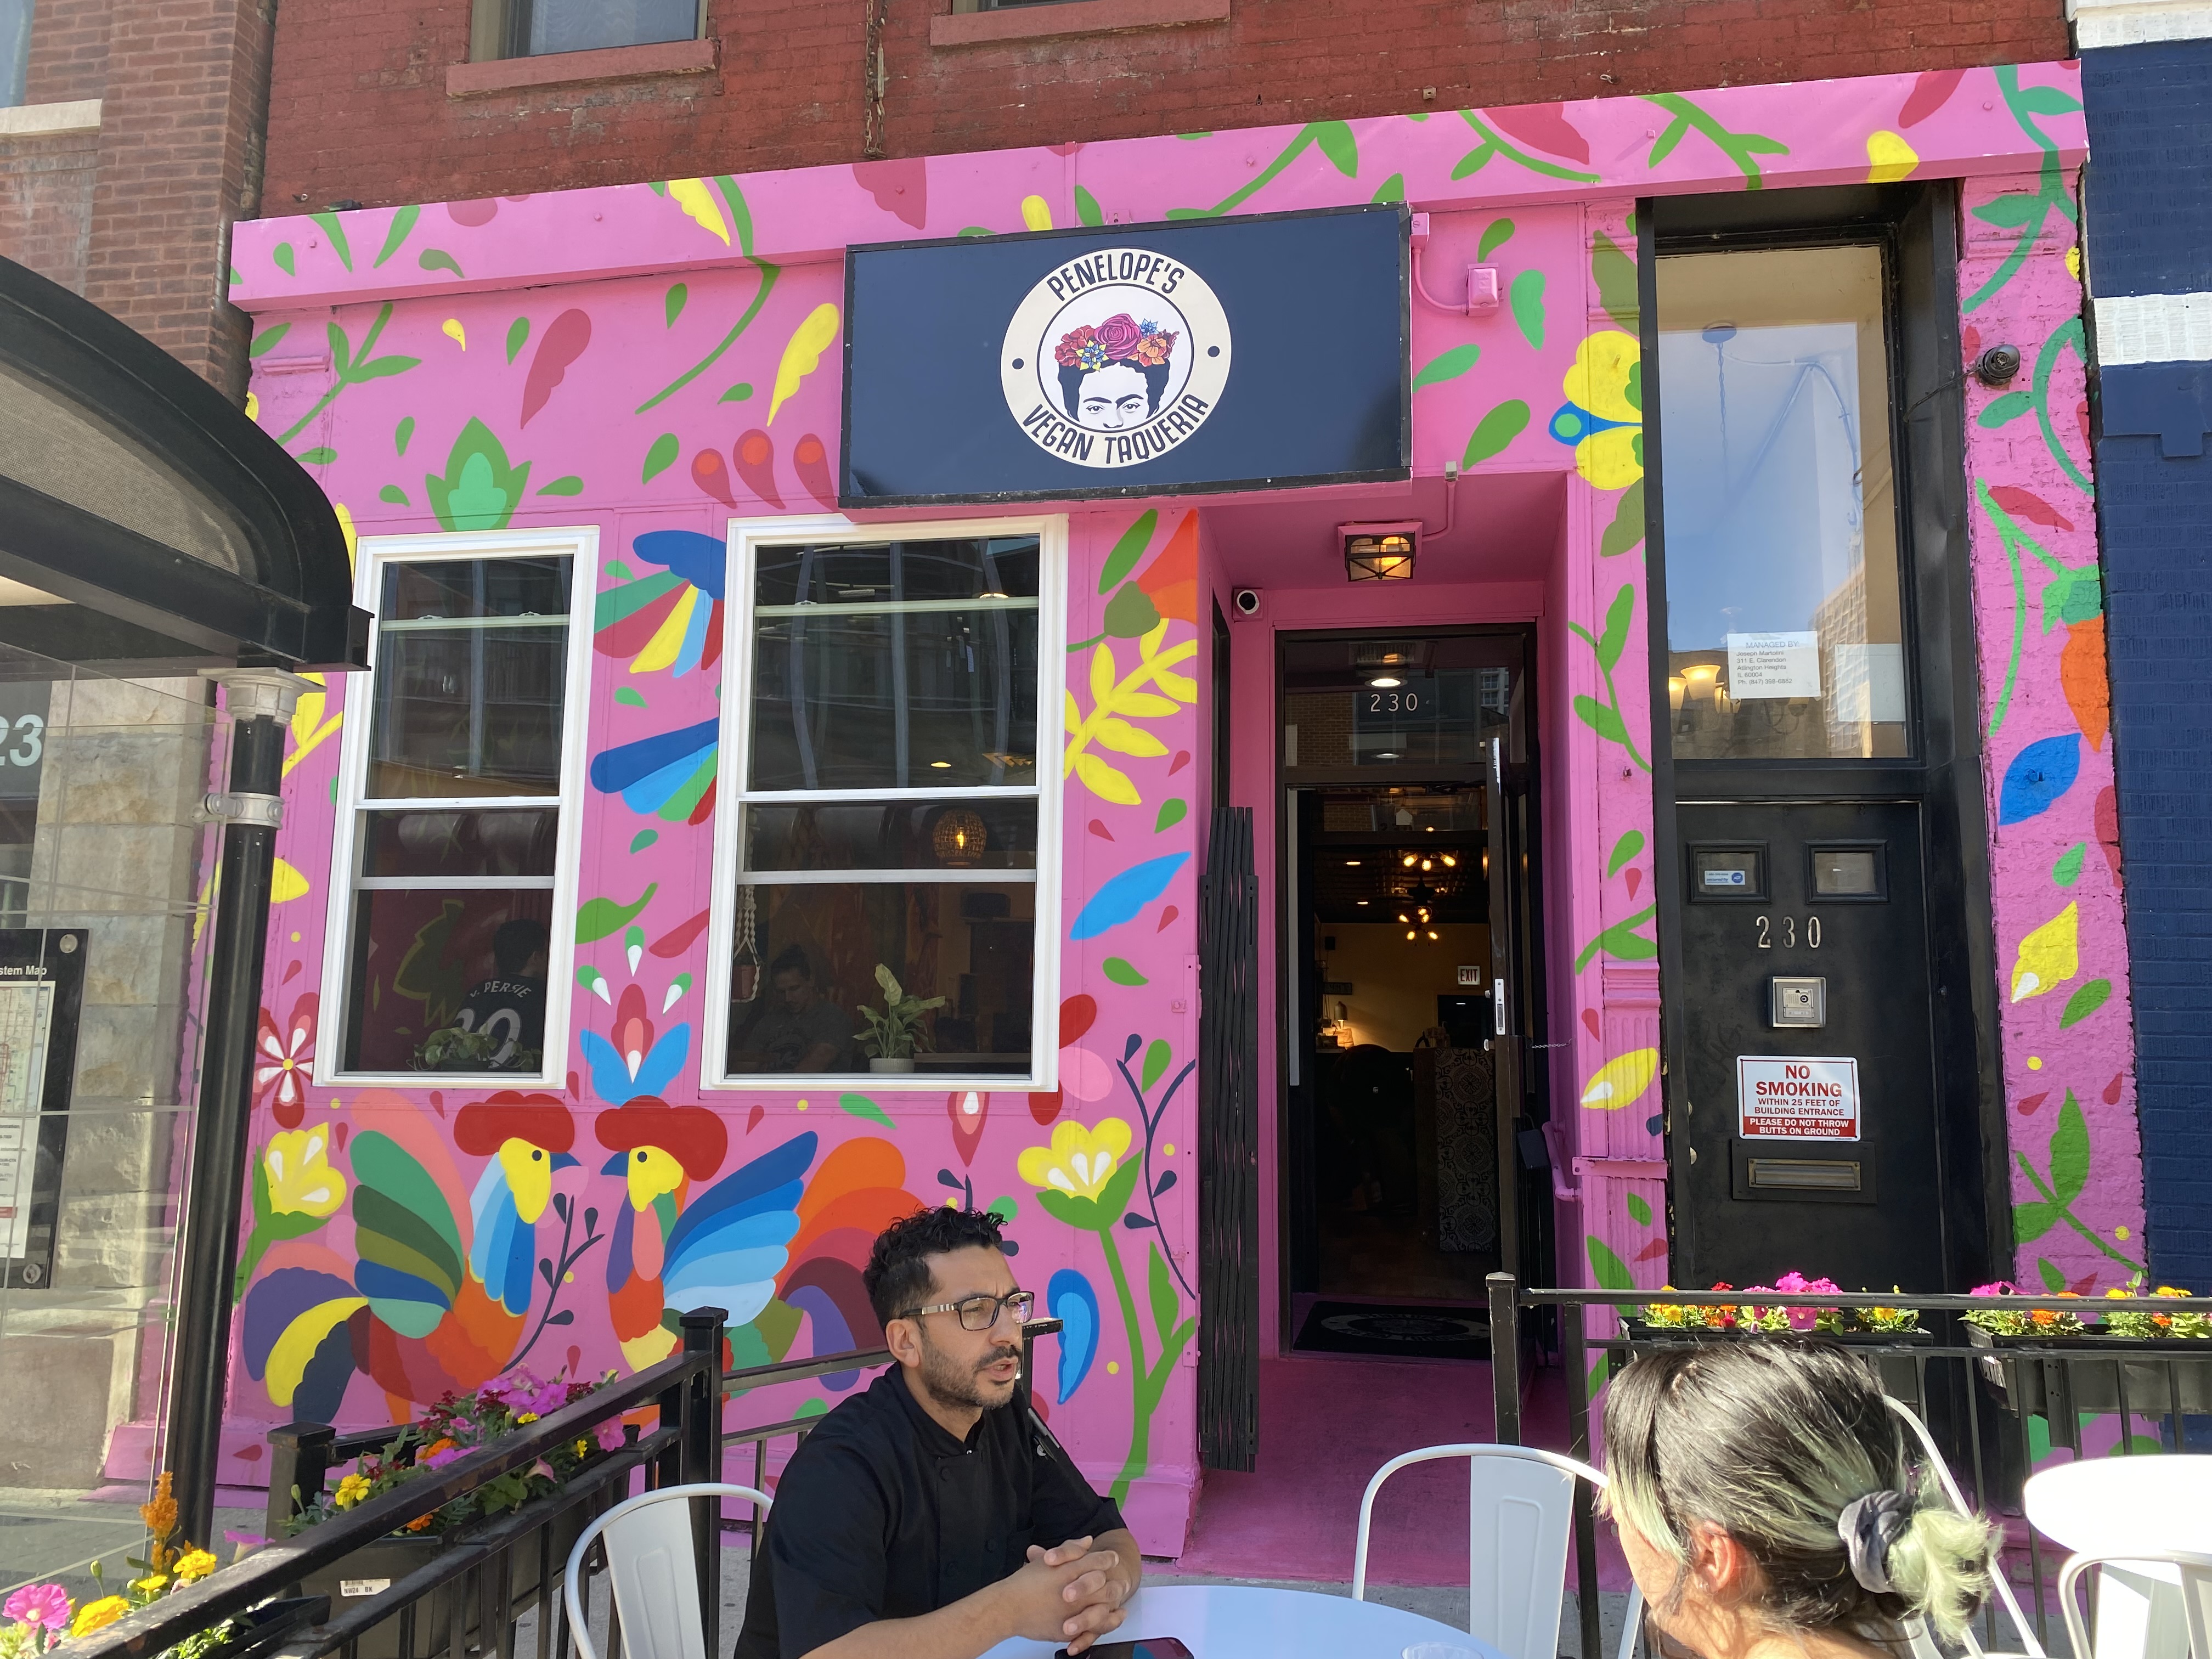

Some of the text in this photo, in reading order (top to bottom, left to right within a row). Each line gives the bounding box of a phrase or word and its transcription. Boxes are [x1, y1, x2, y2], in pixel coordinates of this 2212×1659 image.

[1046, 252, 1185, 302] PENELOPE'S
[1022, 394, 1209, 464] VEGAN TAQUERIA
[1370, 693, 1418, 712] 230
[0, 714, 43, 767] 3
[1756, 916, 1821, 948] 230
[25, 965, 47, 975] Map
[1460, 969, 1478, 982] EXIT
[483, 980, 532, 998] PERSIE
[1786, 1065, 1810, 1079] NO
[1756, 1081, 1842, 1097] SMOKING
[1750, 1118, 1782, 1126] PLEASE
[1816, 1120, 1849, 1128] THROW
[1759, 1126, 1787, 1135] BUTTS
